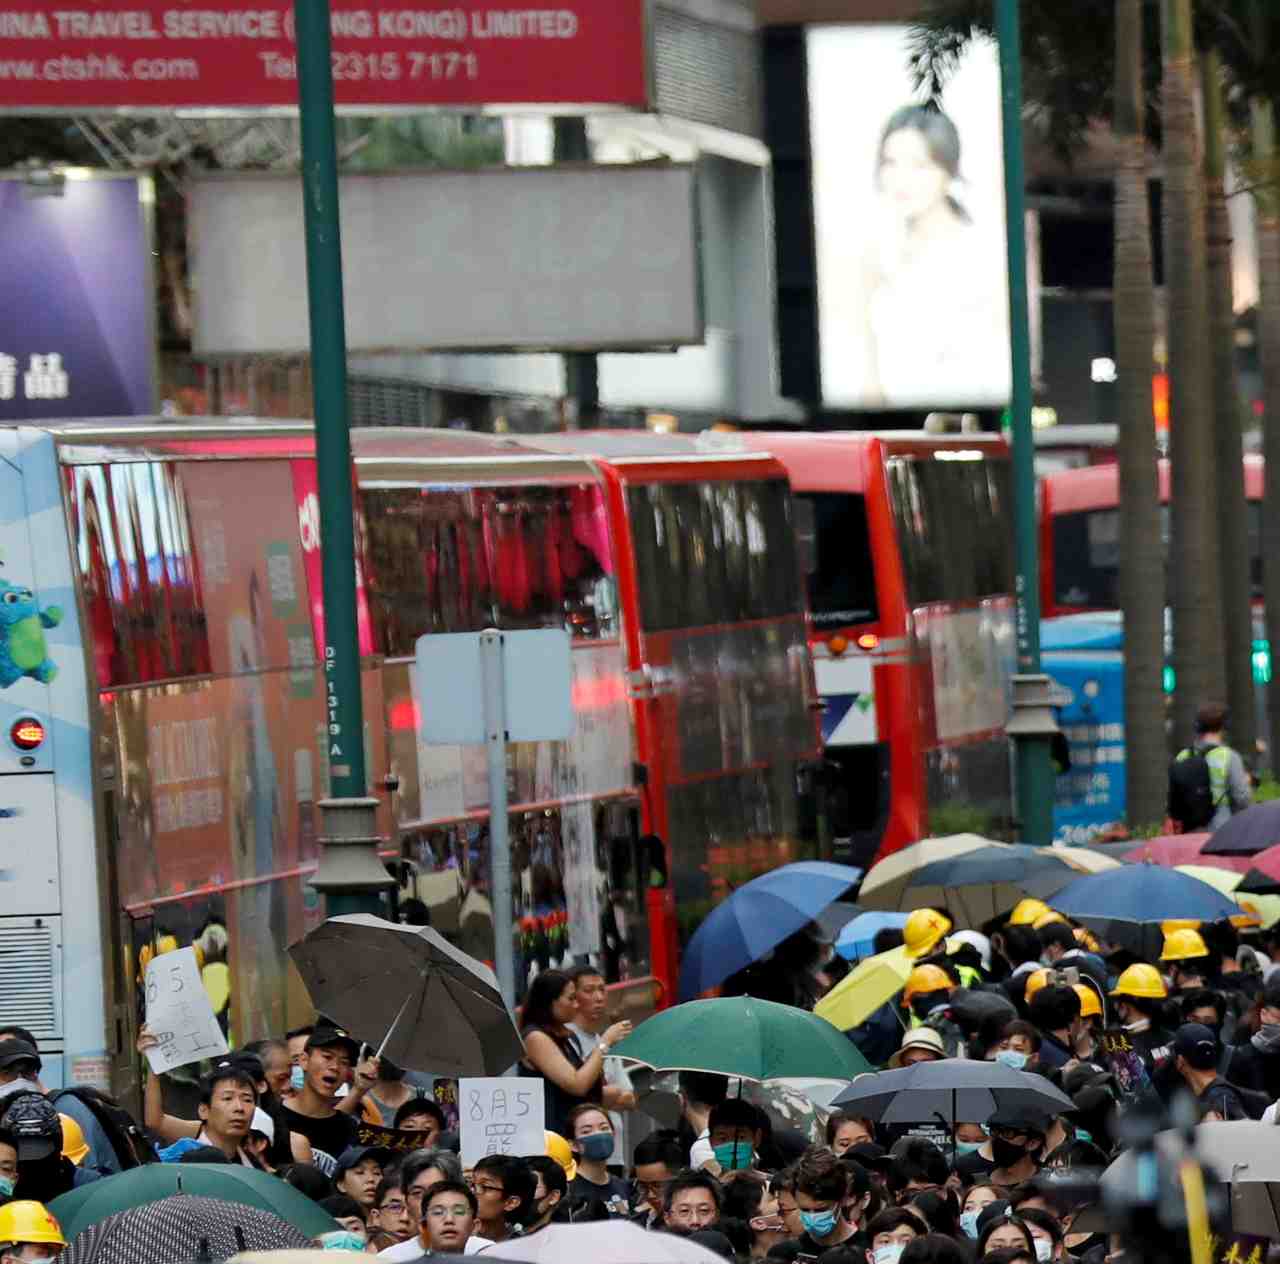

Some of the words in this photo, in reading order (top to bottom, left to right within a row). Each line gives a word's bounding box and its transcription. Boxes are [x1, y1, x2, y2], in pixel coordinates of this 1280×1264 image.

[0, 11, 51, 38] INA
[53, 11, 160, 39] TRAVEL
[163, 11, 277, 39] SERVICE
[284, 11, 372, 40] (NG
[378, 10, 466, 41] KONG)
[472, 10, 578, 38] LIMITED
[332, 51, 400, 80] 2315
[407, 51, 479, 80] 7171
